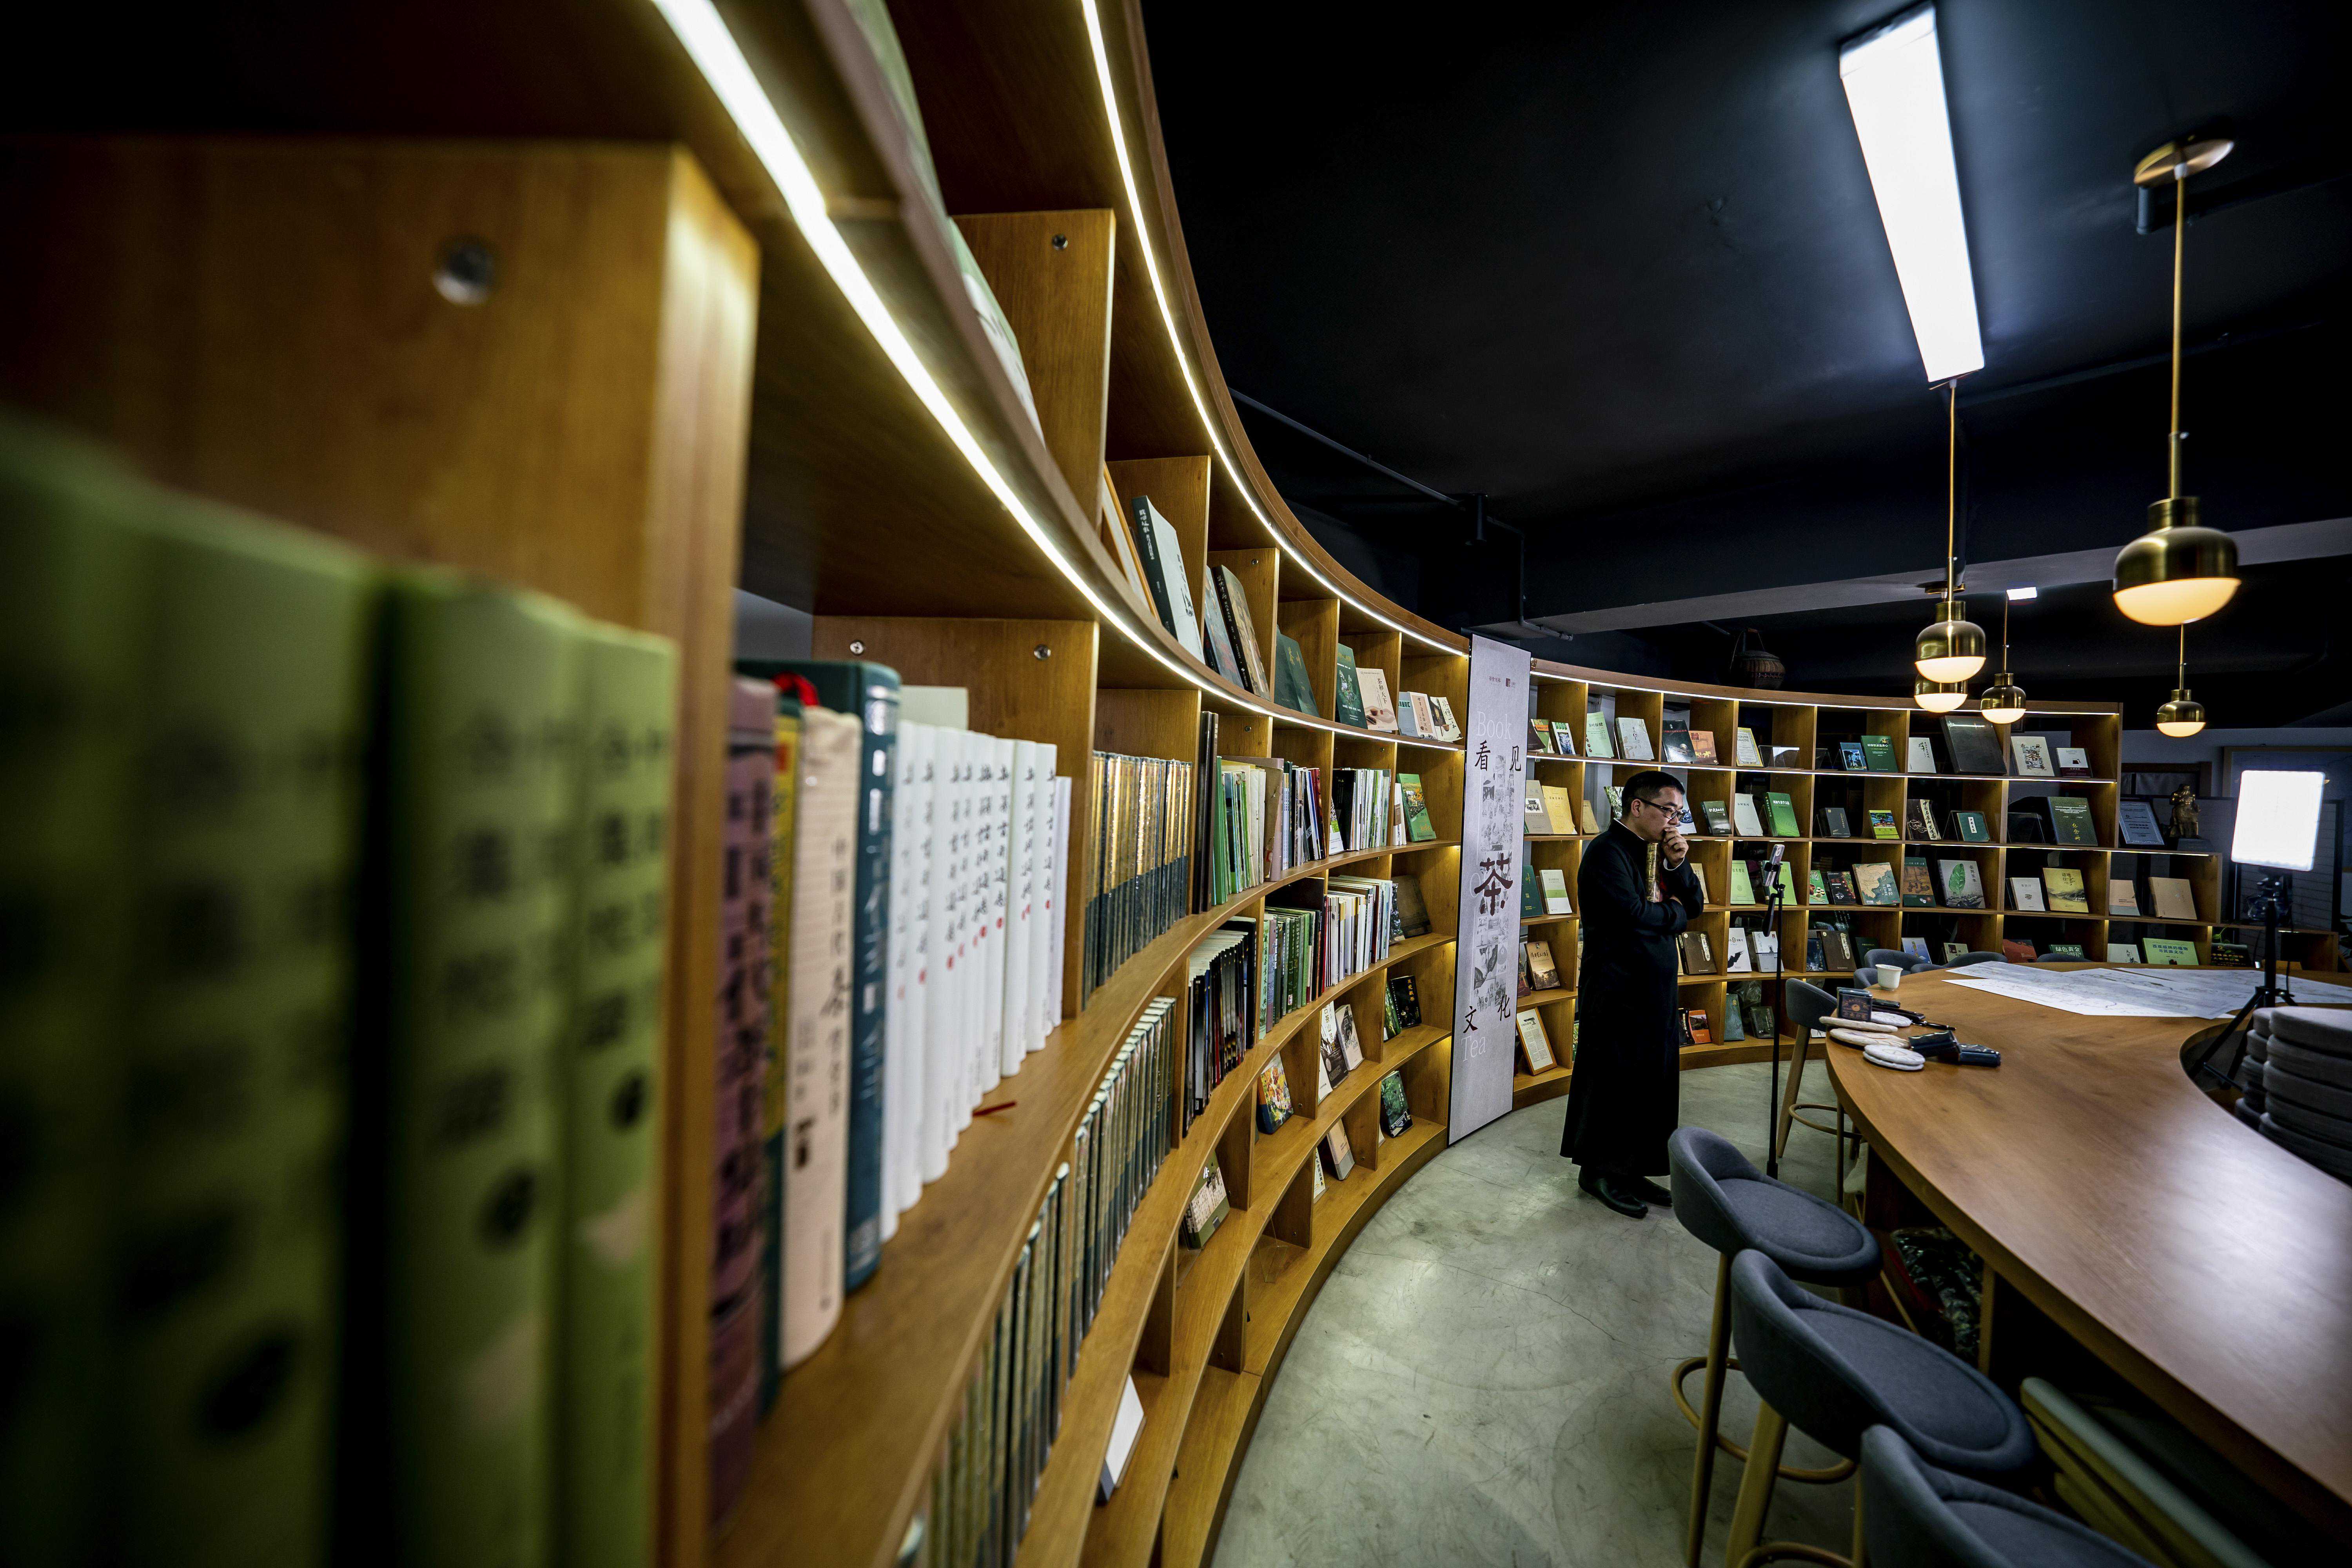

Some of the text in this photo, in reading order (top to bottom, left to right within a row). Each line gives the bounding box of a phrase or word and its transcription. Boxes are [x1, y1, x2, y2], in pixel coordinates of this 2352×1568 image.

[1476, 711, 1512, 740] Book
[1475, 739, 1521, 771] 看 见
[1474, 853, 1513, 916] 茶
[1463, 995, 1511, 1034] 文 化
[1461, 1036, 1486, 1062] Tea
